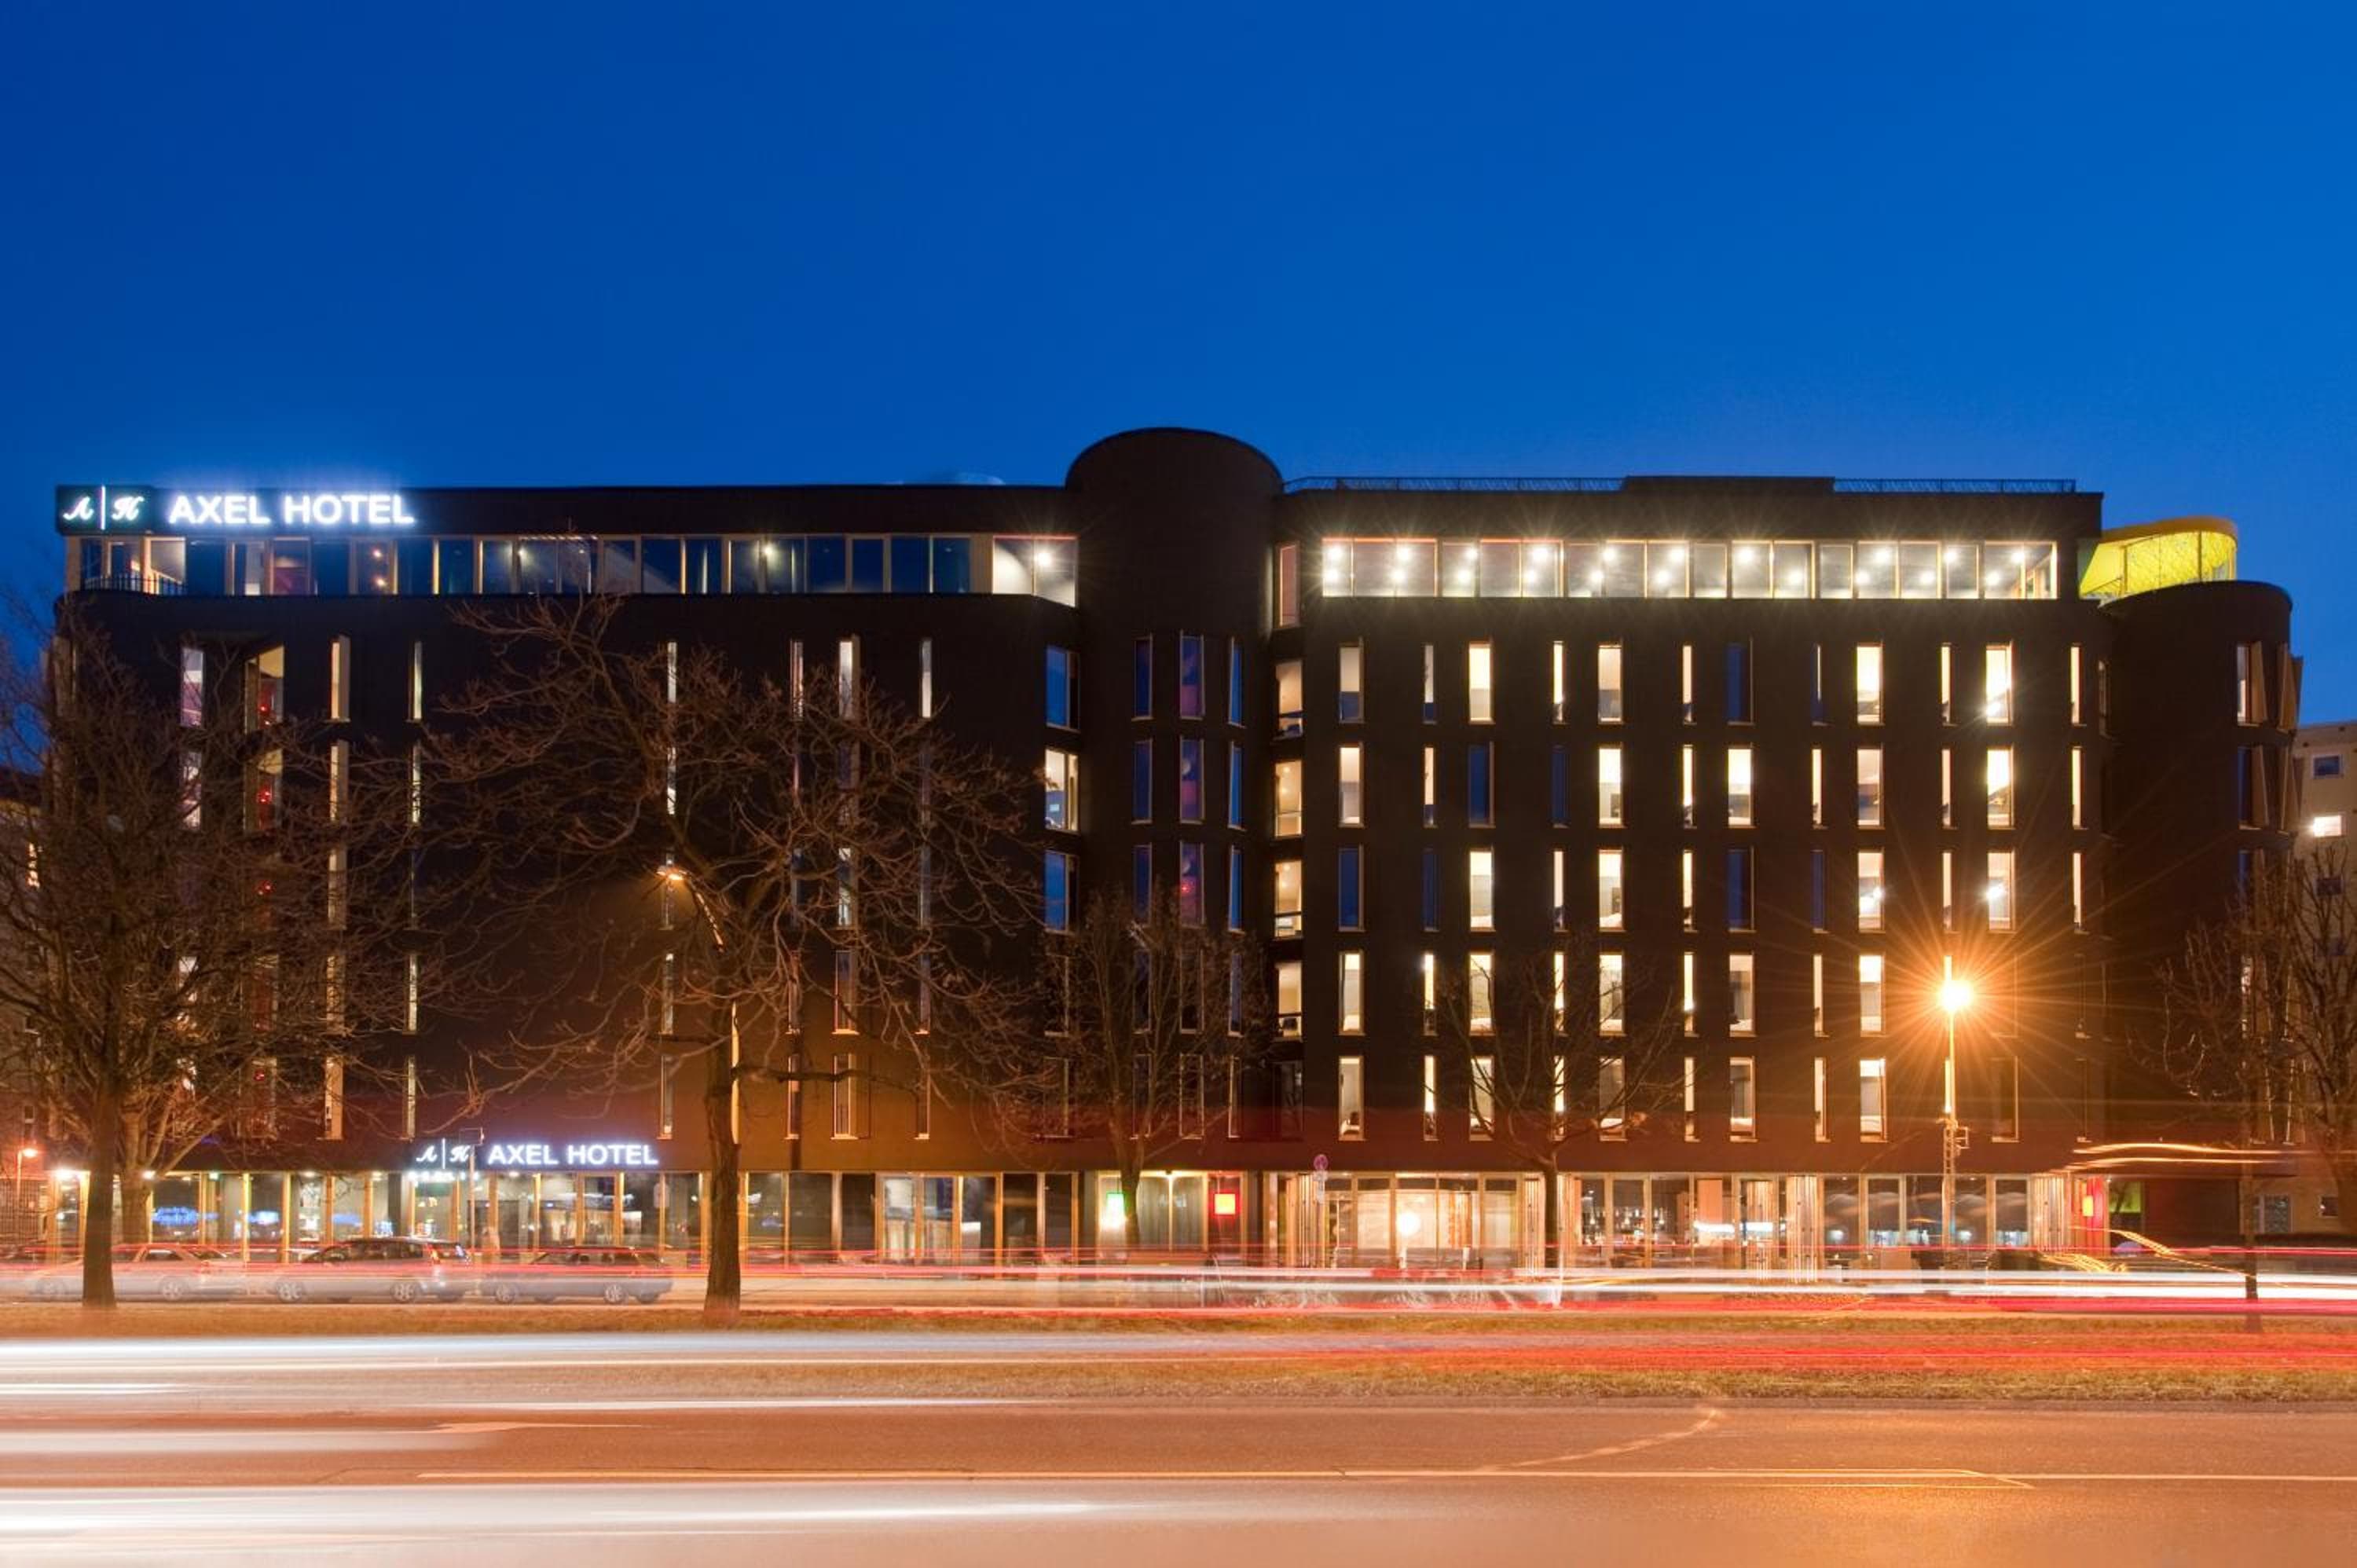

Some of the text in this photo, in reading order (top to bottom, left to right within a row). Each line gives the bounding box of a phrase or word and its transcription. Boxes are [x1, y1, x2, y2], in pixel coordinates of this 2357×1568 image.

[168, 494, 271, 524] AXEL
[283, 494, 414, 524] HOTEL
[487, 1145, 559, 1164] AXEL
[566, 1145, 658, 1164] HOTEL
